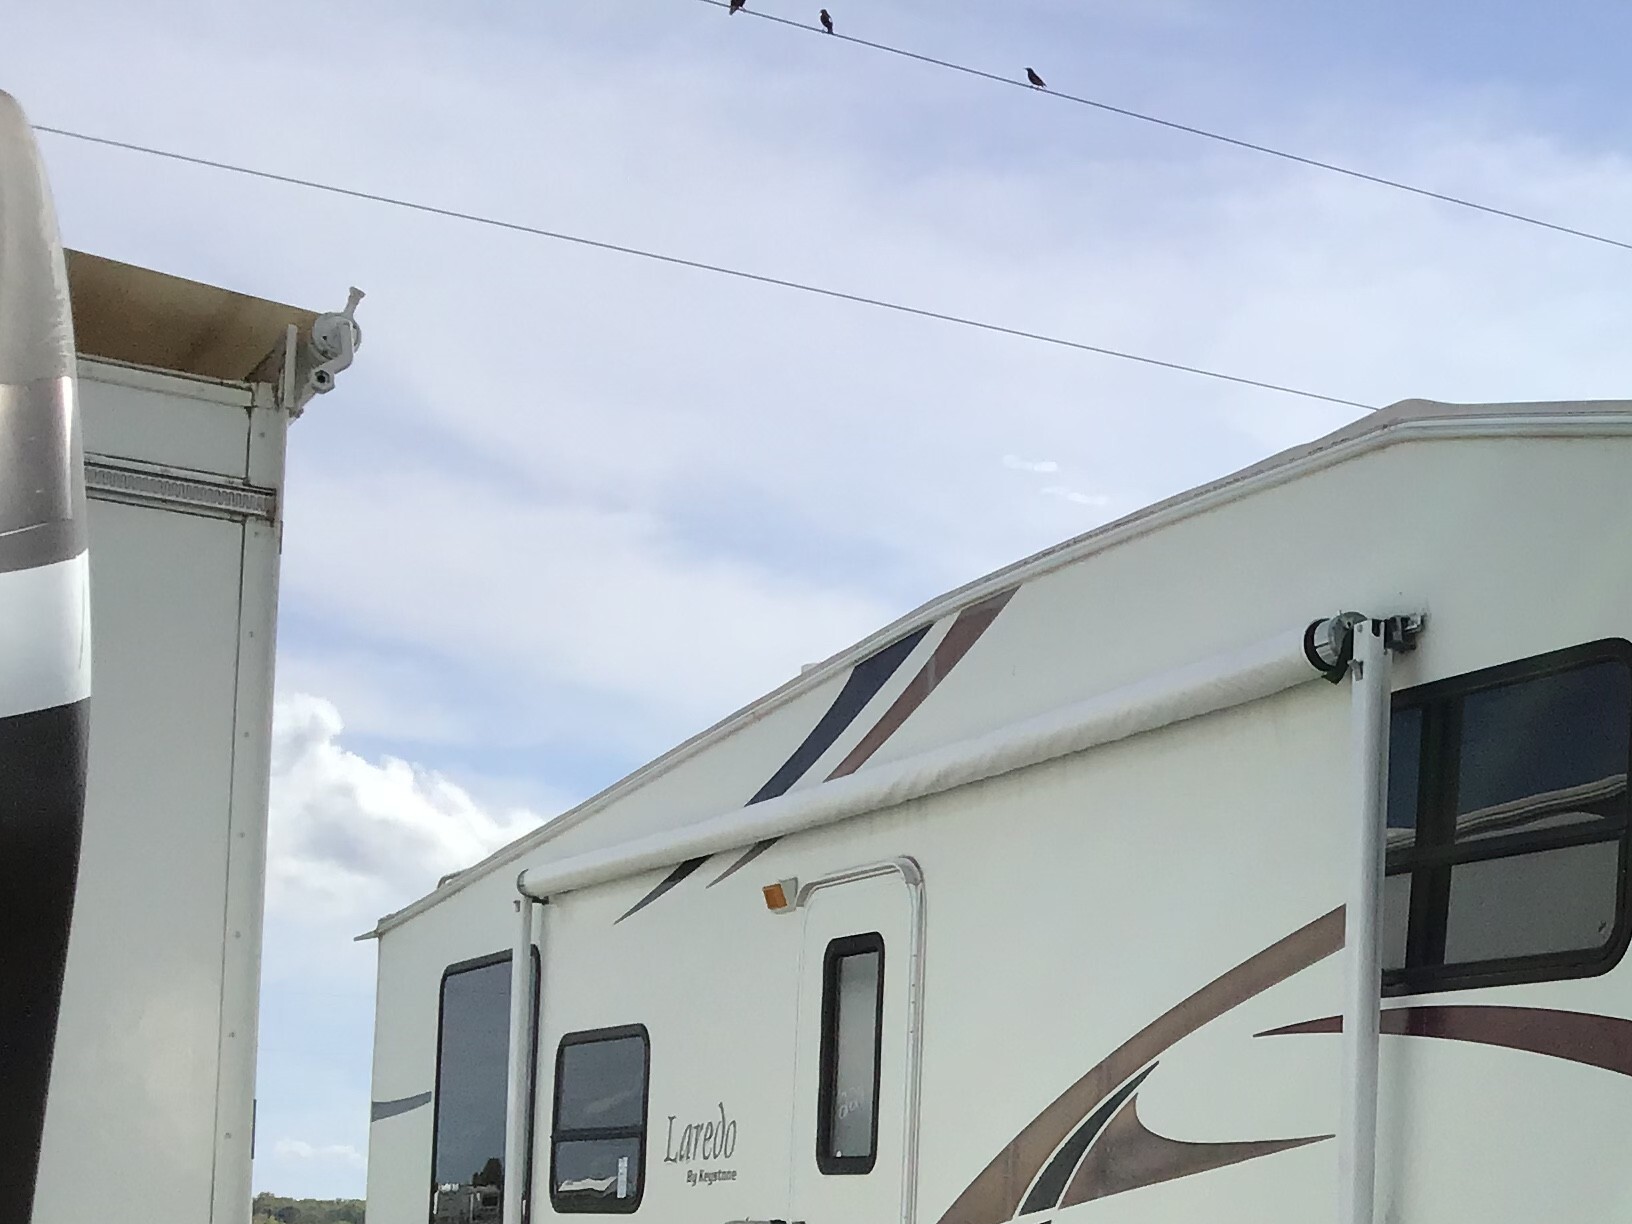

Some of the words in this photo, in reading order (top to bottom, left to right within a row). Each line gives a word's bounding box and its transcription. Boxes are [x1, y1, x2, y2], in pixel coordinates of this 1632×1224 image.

[664, 1102, 737, 1163] Laredo
[686, 1170, 698, 1187] By
[699, 1169, 737, 1186] Keystone
